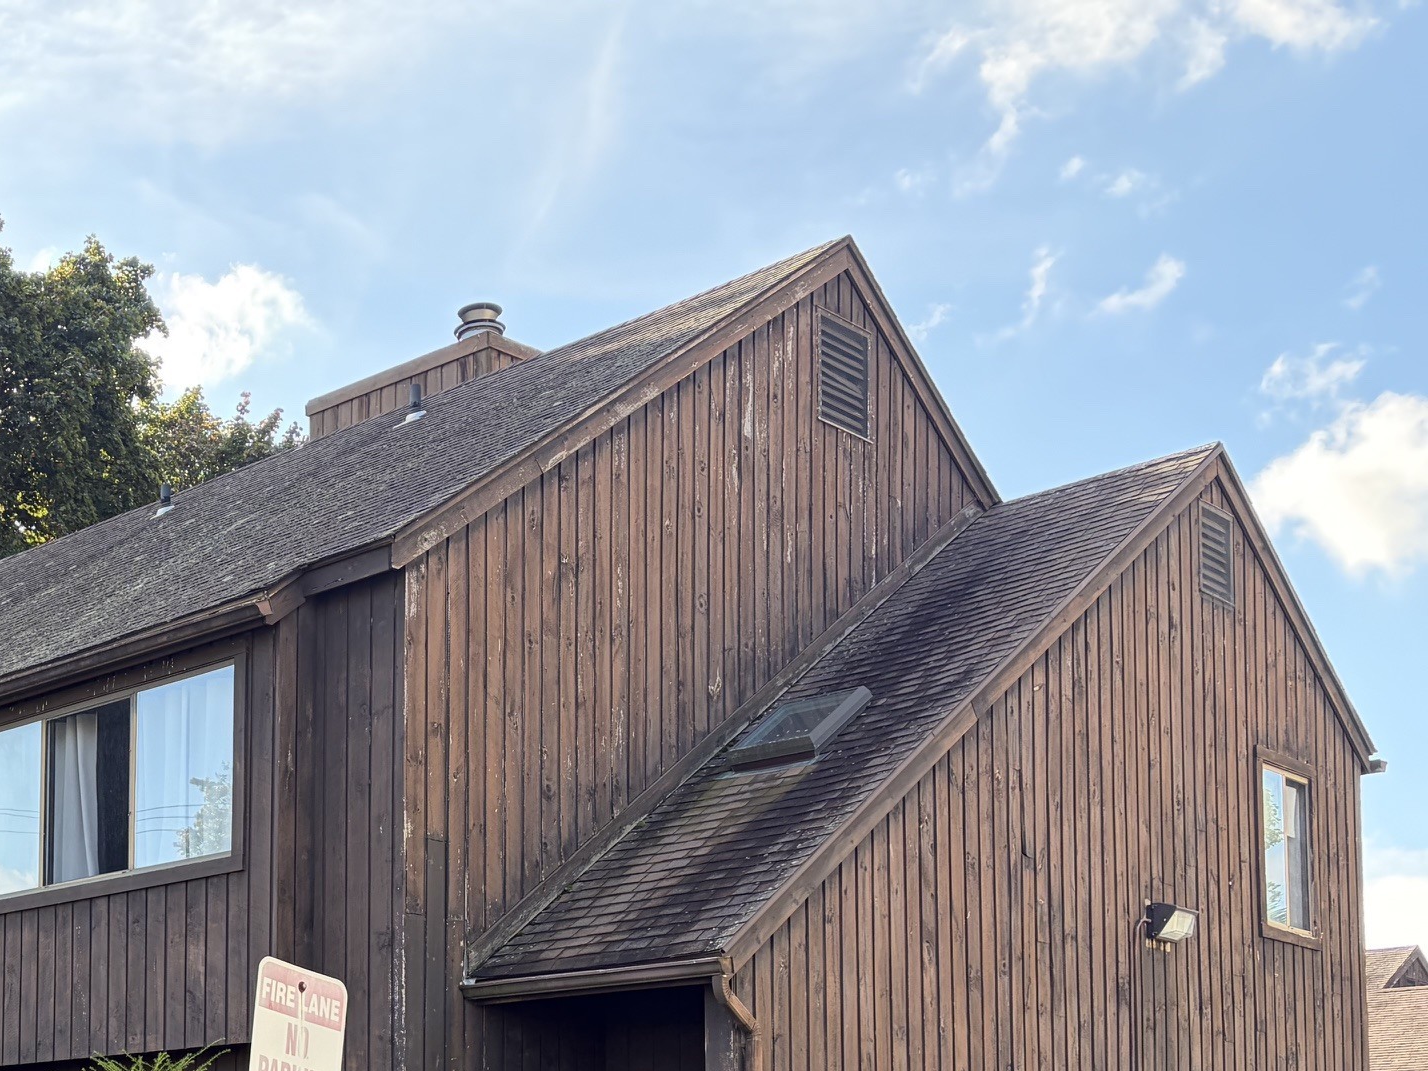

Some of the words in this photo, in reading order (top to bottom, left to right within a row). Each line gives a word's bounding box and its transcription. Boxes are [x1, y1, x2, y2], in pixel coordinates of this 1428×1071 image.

[262, 978, 296, 1008] FIRE
[301, 991, 341, 1023] LANE
[285, 1022, 310, 1060] NO
